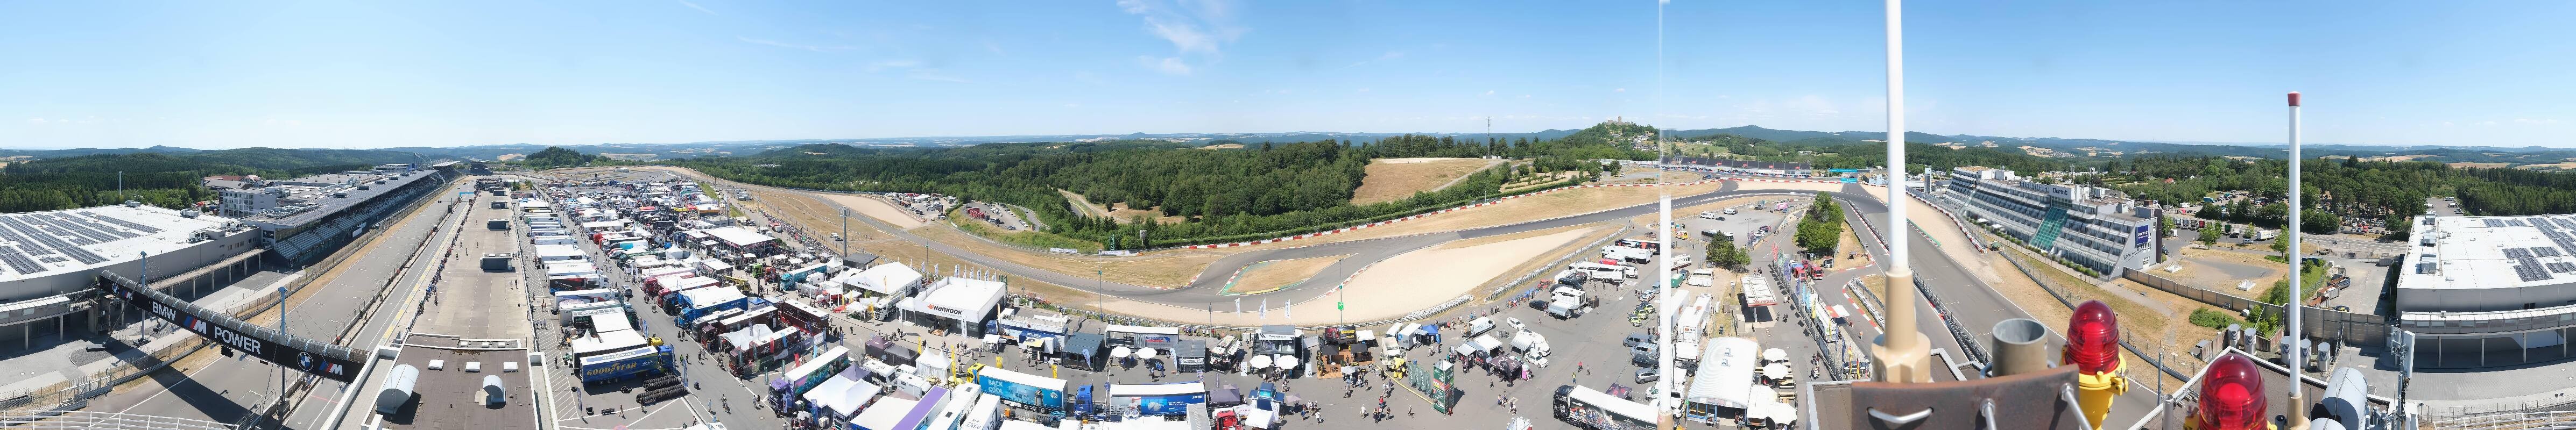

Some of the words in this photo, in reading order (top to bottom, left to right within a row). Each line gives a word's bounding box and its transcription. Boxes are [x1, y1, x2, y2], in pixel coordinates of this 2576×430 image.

[152, 301, 177, 321] BMW
[214, 326, 261, 355] POWER
[587, 362, 637, 376] GOODYEAR
[988, 379, 1003, 387] BACK
